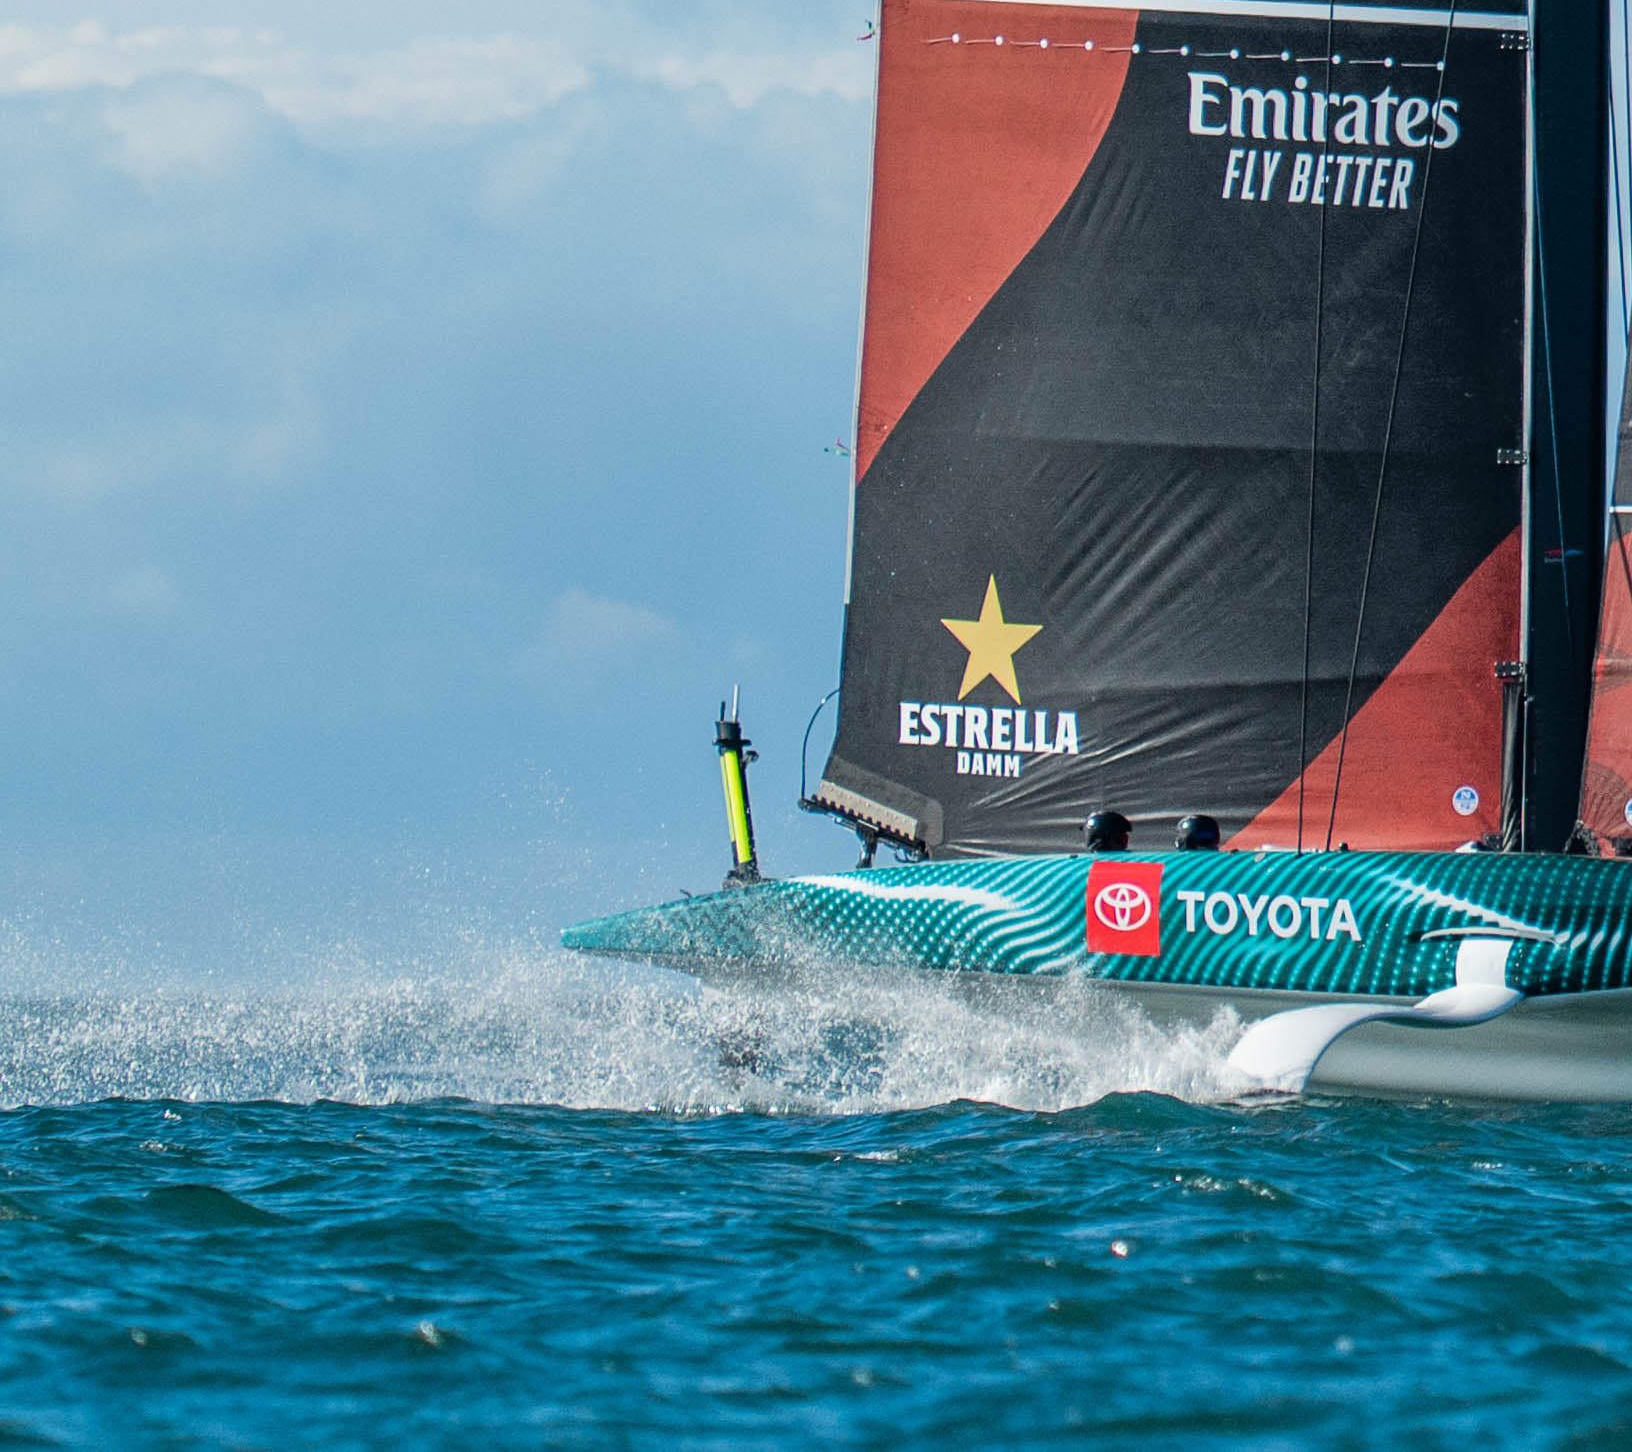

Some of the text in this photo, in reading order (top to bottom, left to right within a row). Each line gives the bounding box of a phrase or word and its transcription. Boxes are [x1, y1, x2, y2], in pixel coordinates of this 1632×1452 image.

[1187, 71, 1460, 150] Emirates
[1221, 148, 1416, 211] FLY BETTER
[898, 701, 1081, 755] ESTRELLA
[956, 750, 1021, 778] DAMM
[1176, 891, 1362, 941] TOYOTA
